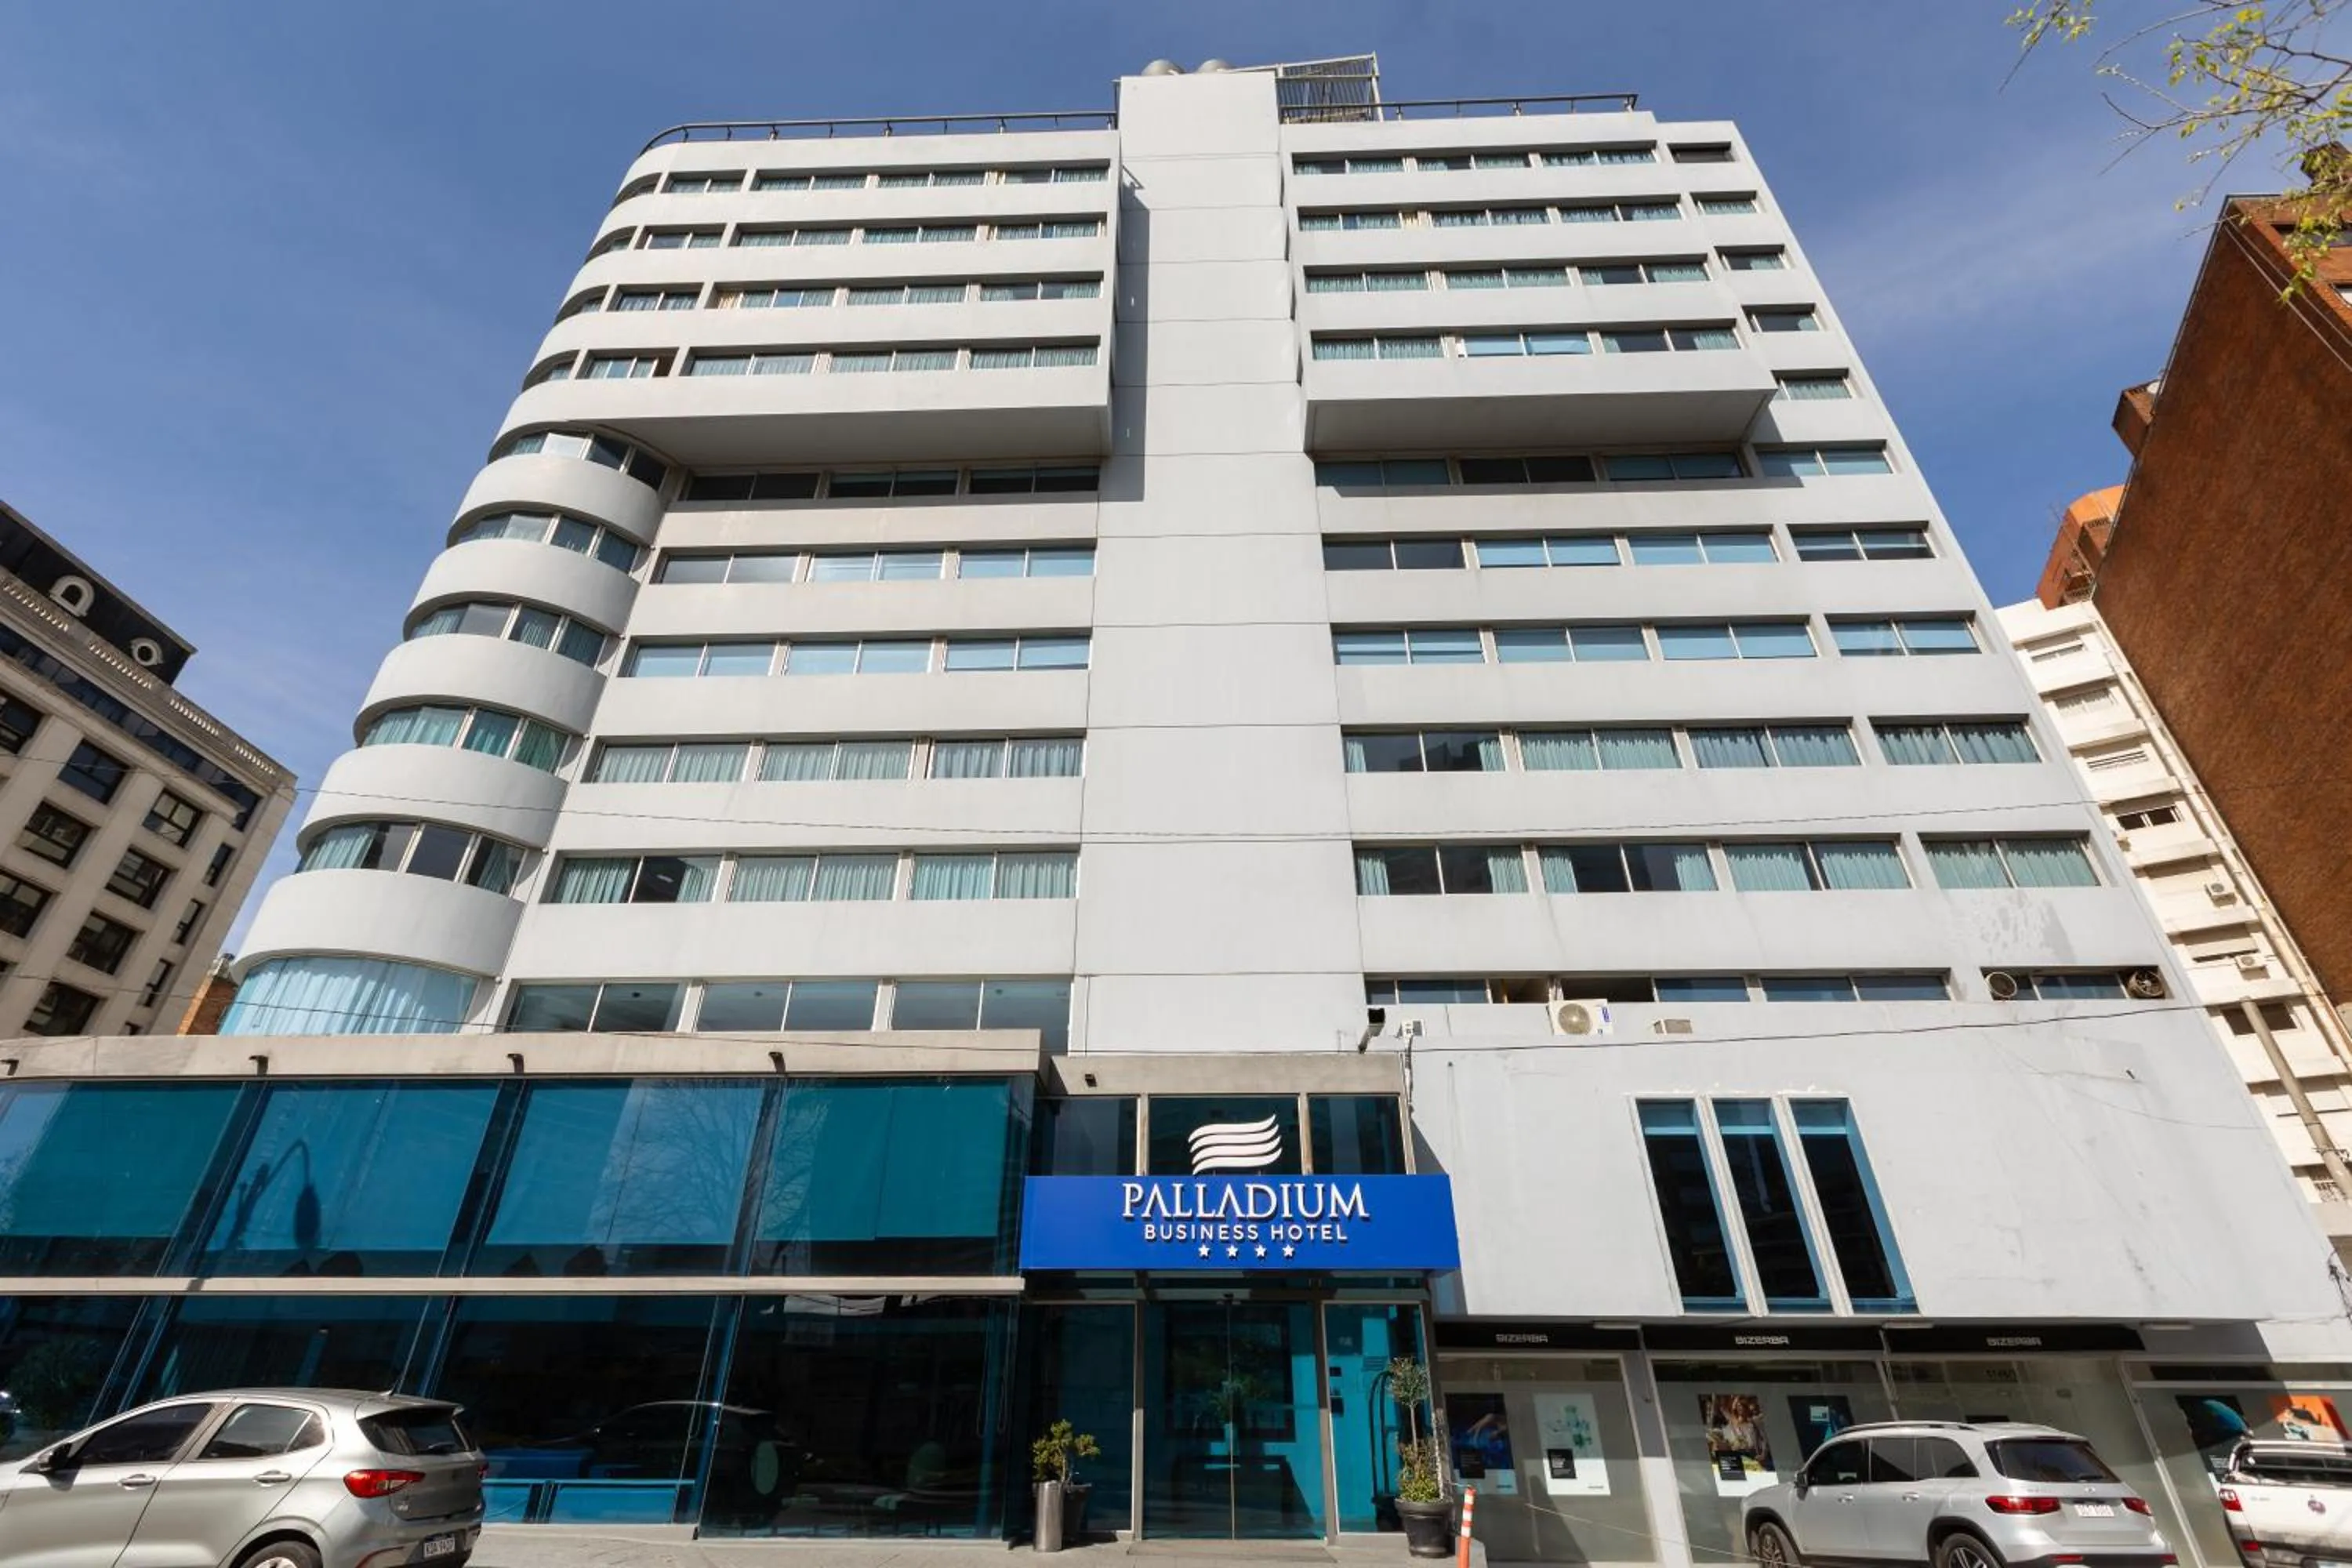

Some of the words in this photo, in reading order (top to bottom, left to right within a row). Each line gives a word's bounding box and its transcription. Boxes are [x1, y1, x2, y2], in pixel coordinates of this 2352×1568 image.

[1122, 1182, 1370, 1218] PALLADIUM
[1144, 1224, 1259, 1240] BUSINESS
[1270, 1224, 1348, 1240] HOTEL
[1495, 1334, 1548, 1343] BIZERBA
[1735, 1335, 1790, 1345] BIZERBA
